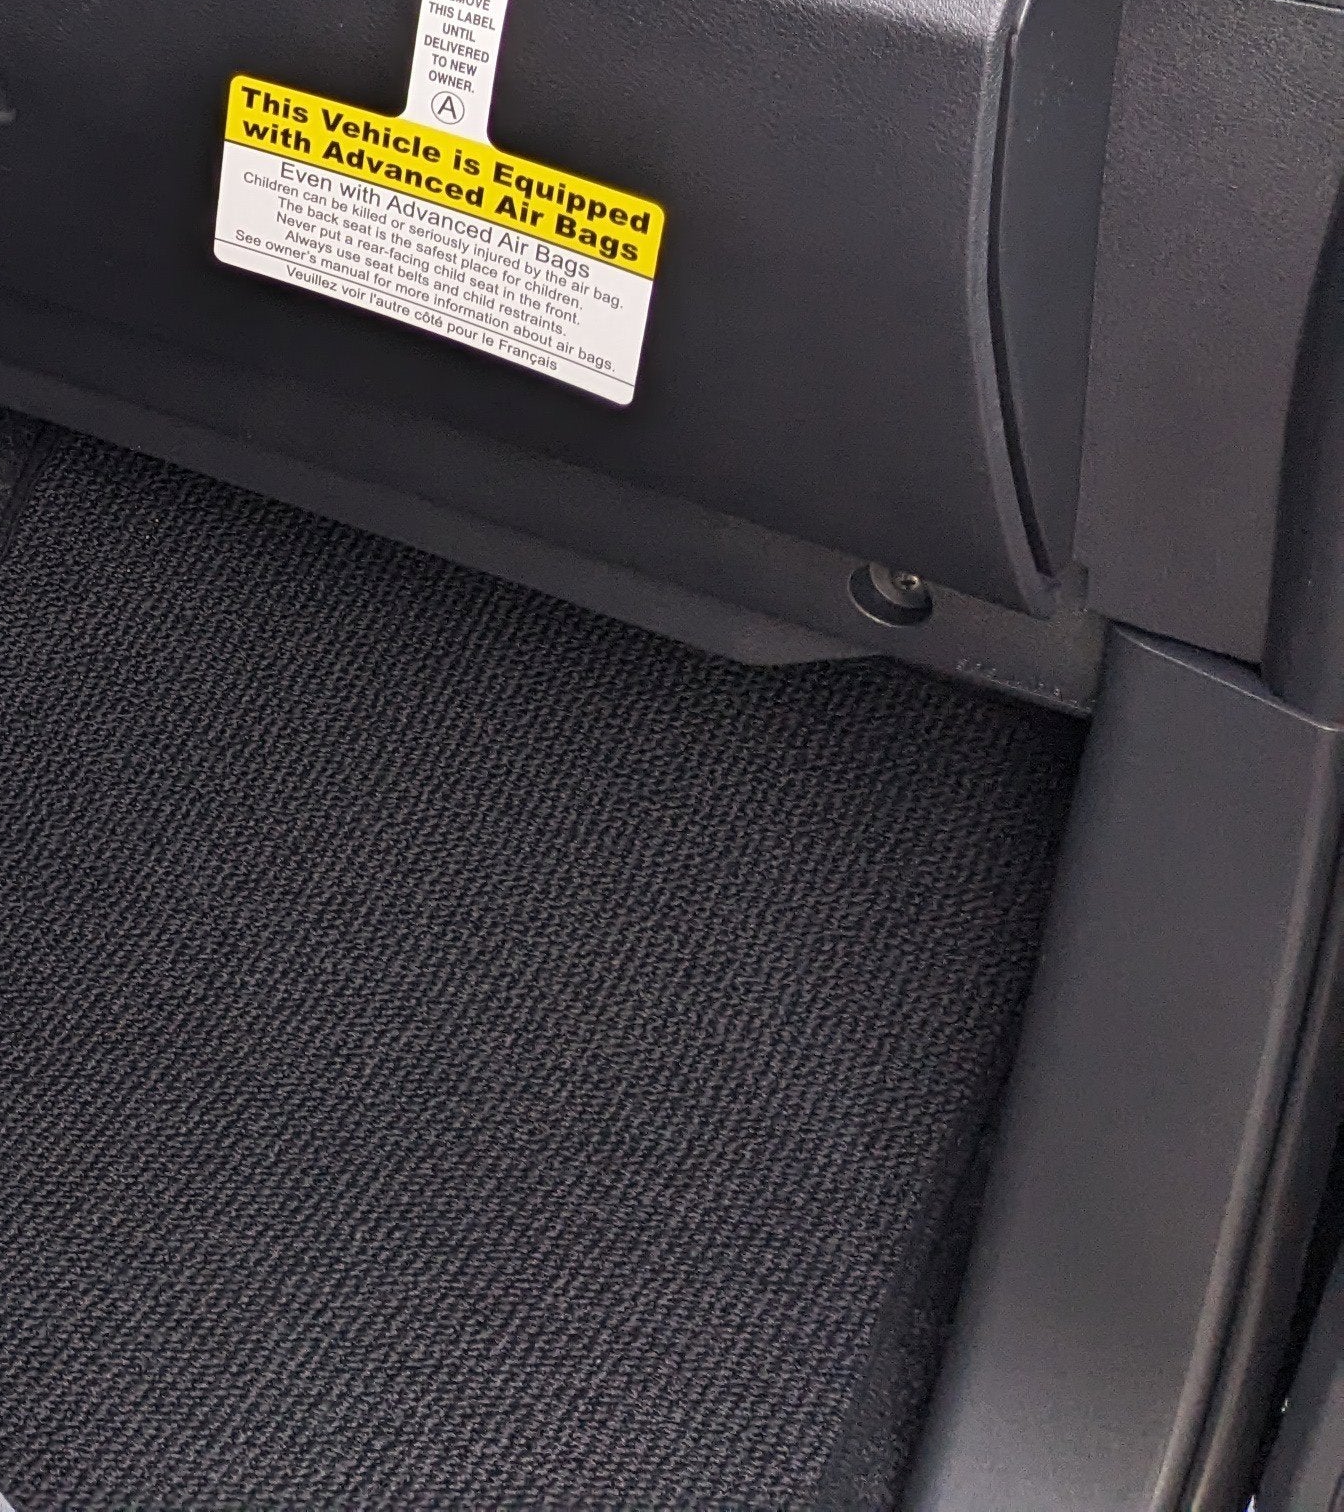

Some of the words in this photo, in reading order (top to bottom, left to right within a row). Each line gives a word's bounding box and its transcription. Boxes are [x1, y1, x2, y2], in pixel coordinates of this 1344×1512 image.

[424, 35, 489, 63] DELIVERED
[429, 1, 454, 19] THIS
[458, 10, 496, 30] LABEL
[432, 53, 447, 68] TO
[451, 59, 477, 76] NEW
[443, 23, 475, 42] UNTIL
[429, 70, 475, 93] OWNER.
[438, 95, 457, 120] A
[240, 85, 309, 125] This
[320, 107, 442, 164] Vehicle
[452, 153, 481, 177] is
[492, 160, 652, 235] Equipped
[242, 119, 312, 155] with
[321, 139, 486, 209] Advanced
[494, 194, 545, 228] Air
[554, 212, 639, 263] Bags
[242, 170, 300, 198] Children
[302, 190, 328, 207] can
[330, 196, 349, 213] be
[351, 203, 388, 226] killed
[390, 218, 406, 231] or
[407, 224, 471, 255] seriously
[472, 246, 521, 271] injured
[523, 260, 543, 281] by
[544, 268, 568, 288] the
[570, 281, 590, 296] air
[592, 286, 624, 312] bag.
[275, 210, 318, 234] Never
[318, 226, 342, 243] put
[343, 234, 354, 247] a
[356, 238, 431, 274] rear-facing
[433, 264, 467, 284] child
[468, 276, 500, 296] seat
[501, 288, 516, 302] in
[518, 292, 542, 311] the
[544, 301, 581, 326] front.
[277, 195, 304, 215] The
[306, 204, 339, 226] back
[342, 218, 372, 237] seat
[374, 228, 387, 241] is
[390, 231, 413, 250] the
[415, 242, 458, 266] safest
[459, 257, 499, 279] place
[501, 269, 521, 287] for
[523, 280, 583, 310] children.
[279, 160, 333, 193] Even
[338, 181, 382, 208] with
[385, 194, 494, 245] Advanced
[496, 231, 530, 257] Air
[534, 242, 591, 279] Bags
[234, 228, 263, 248] See
[264, 240, 318, 265] owner's
[319, 257, 371, 282] manual
[373, 272, 393, 289] for
[394, 282, 431, 303] more
[432, 295, 510, 332] information
[512, 324, 553, 348] about
[555, 340, 576, 355] air
[577, 346, 617, 372] bags.
[284, 229, 333, 255] Always
[335, 247, 362, 264] use
[364, 256, 394, 275] seat
[396, 264, 430, 287] belts
[432, 280, 460, 298] and
[462, 290, 496, 310] child
[498, 303, 568, 337] restraints.
[285, 264, 338, 293] Veuillez
[340, 284, 367, 301] voir
[368, 292, 411, 317] l'autre
[413, 310, 444, 329] côté
[446, 322, 479, 341] pour
[481, 331, 495, 348] le
[497, 338, 558, 372] Français
